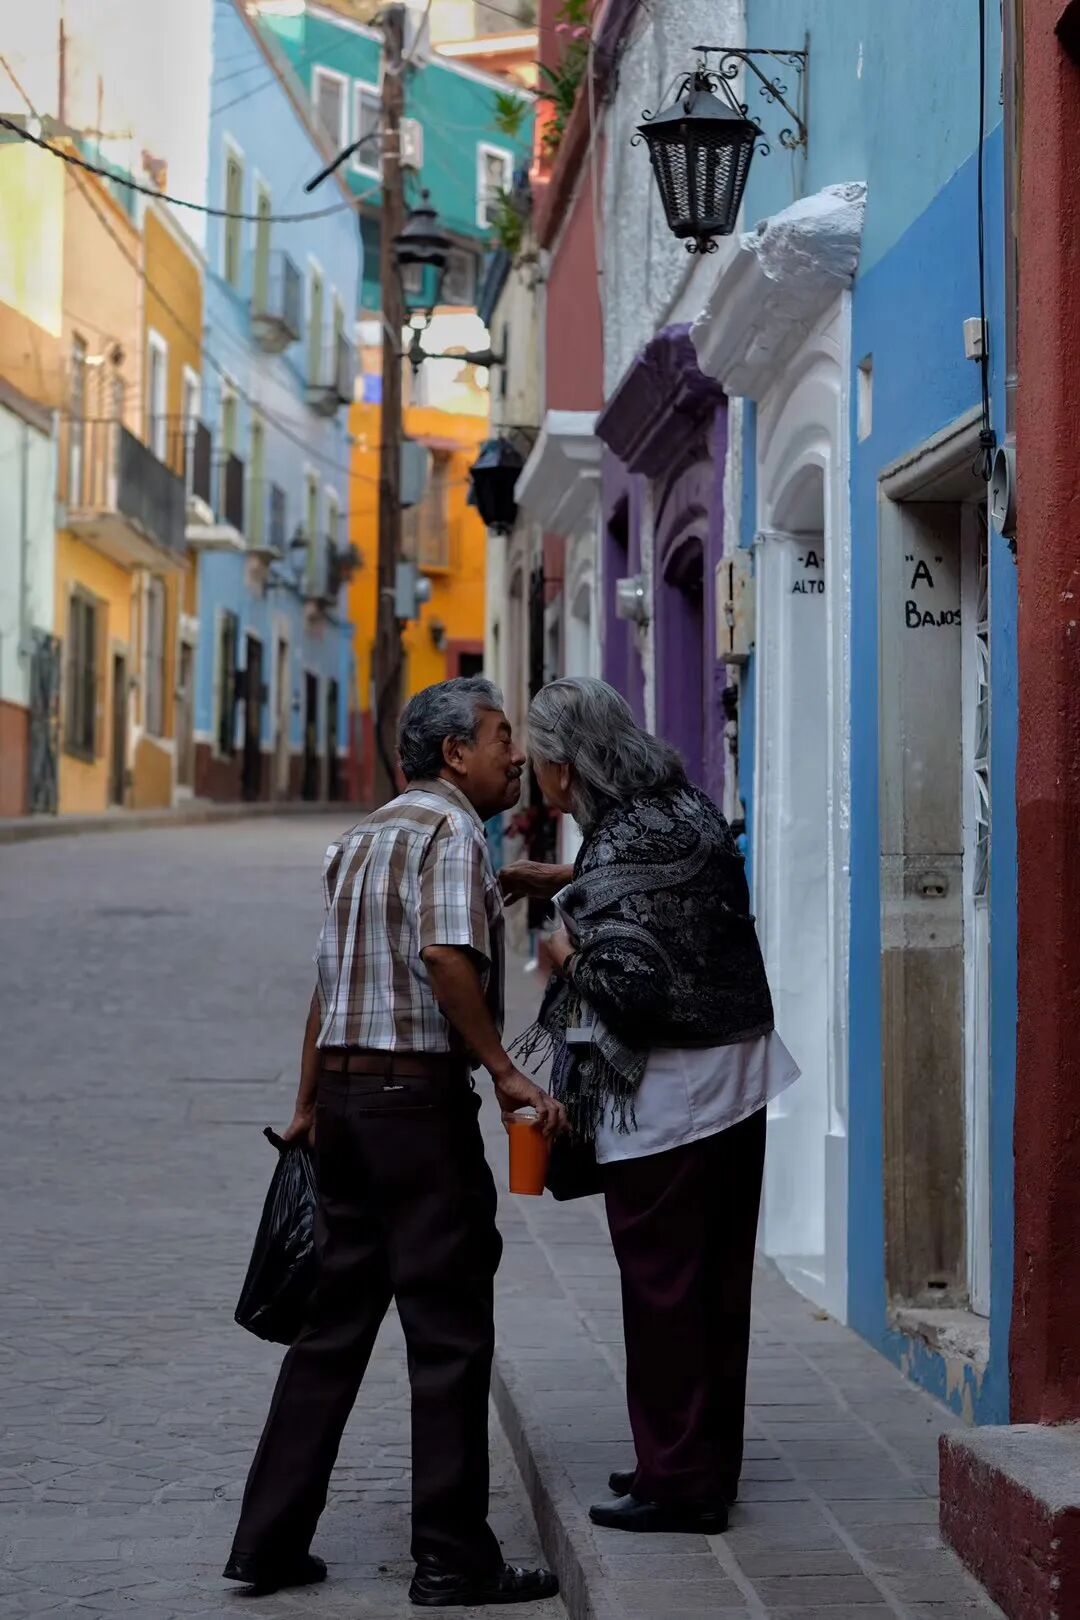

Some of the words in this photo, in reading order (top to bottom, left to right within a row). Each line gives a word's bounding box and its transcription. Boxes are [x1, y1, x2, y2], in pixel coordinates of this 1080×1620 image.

[905, 555, 942, 589] "A"
[792, 580, 824, 594] ALTO
[905, 600, 961, 628] BAJOS
